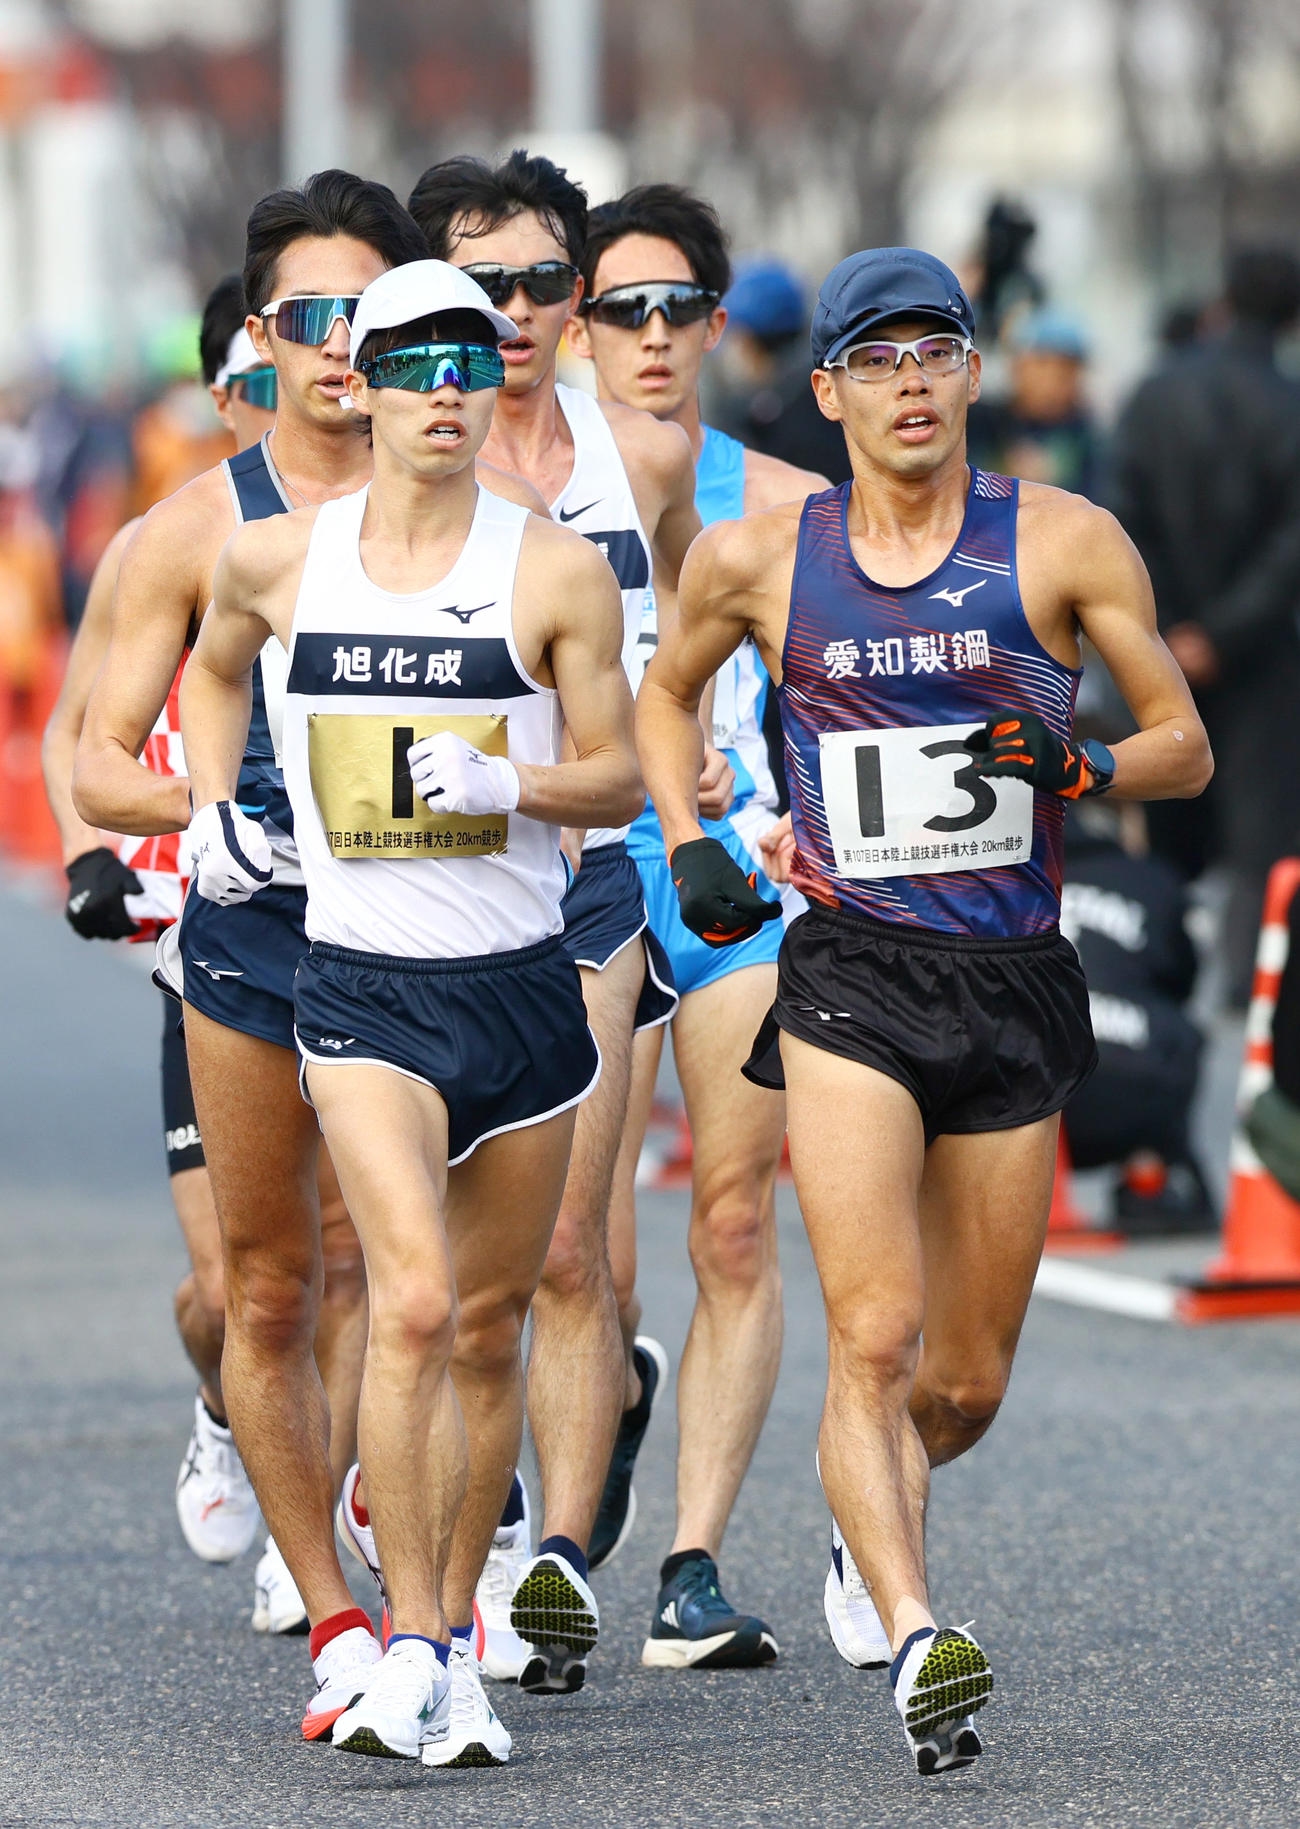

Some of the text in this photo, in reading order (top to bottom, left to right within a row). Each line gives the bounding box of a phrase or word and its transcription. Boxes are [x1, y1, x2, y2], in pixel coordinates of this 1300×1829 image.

[332, 646, 463, 686] 旭化成
[823, 629, 991, 679] 愛知製鋼
[392, 727, 414, 818] 1
[855, 740, 997, 838] 13
[327, 829, 501, 849] 7回日本陸上競技選手権大会 20km競歩
[843, 835, 1024, 864] 第107回日本陸上競技選手権大会 20km競歩
